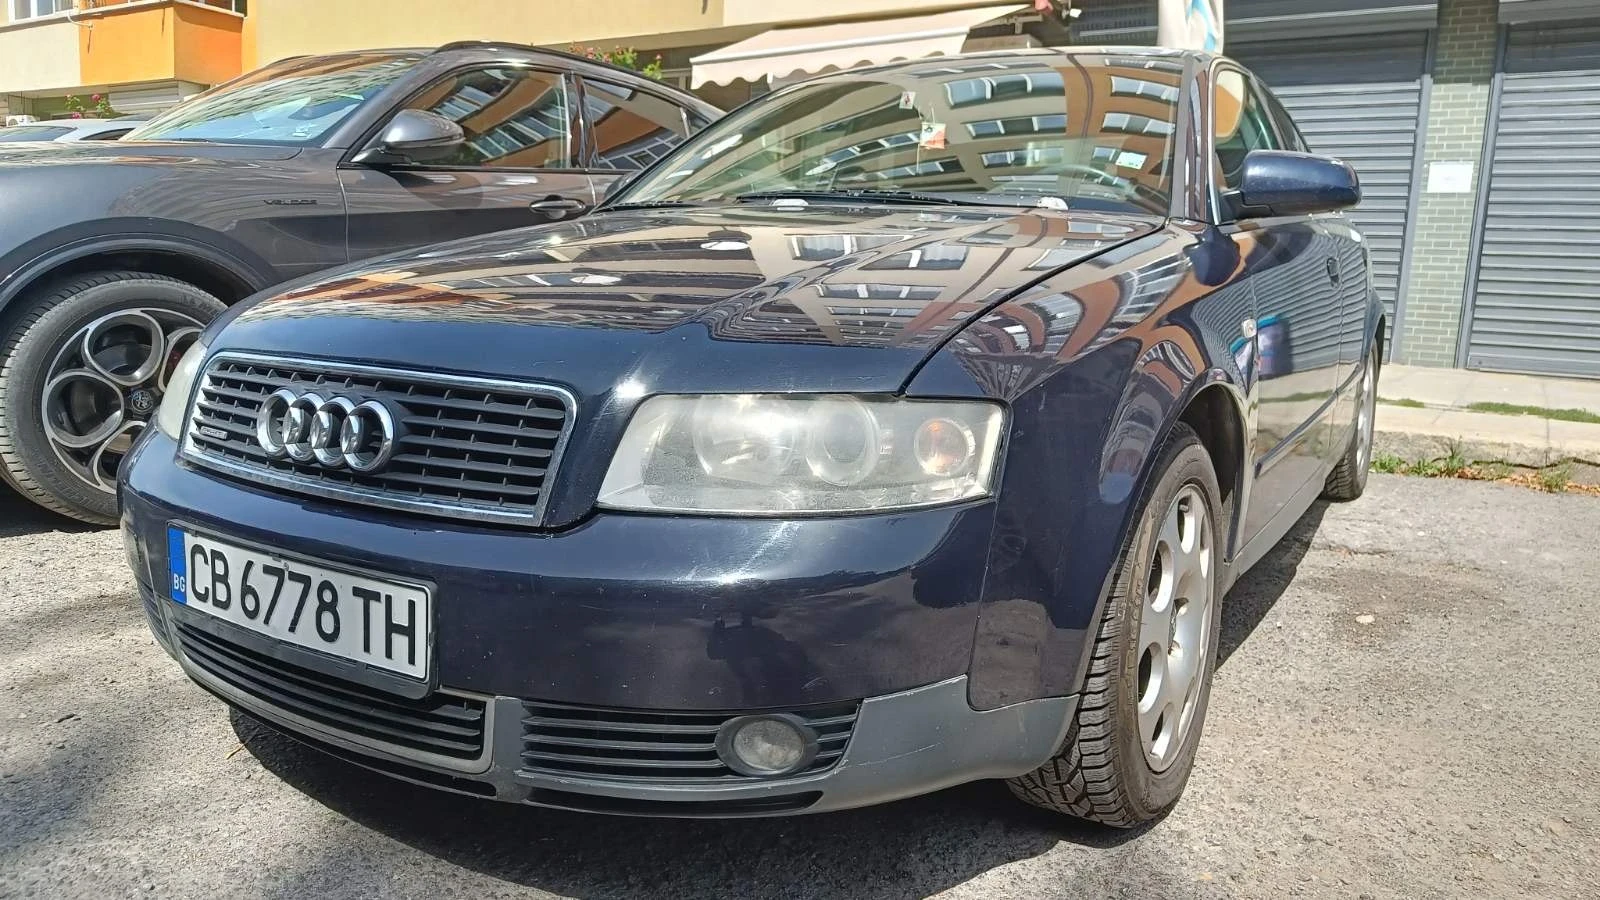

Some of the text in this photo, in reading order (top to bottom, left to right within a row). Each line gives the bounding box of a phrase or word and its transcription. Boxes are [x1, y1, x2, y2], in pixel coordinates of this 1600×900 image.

[173, 573, 186, 592] BG
[190, 543, 416, 666] CB 6778 TH
